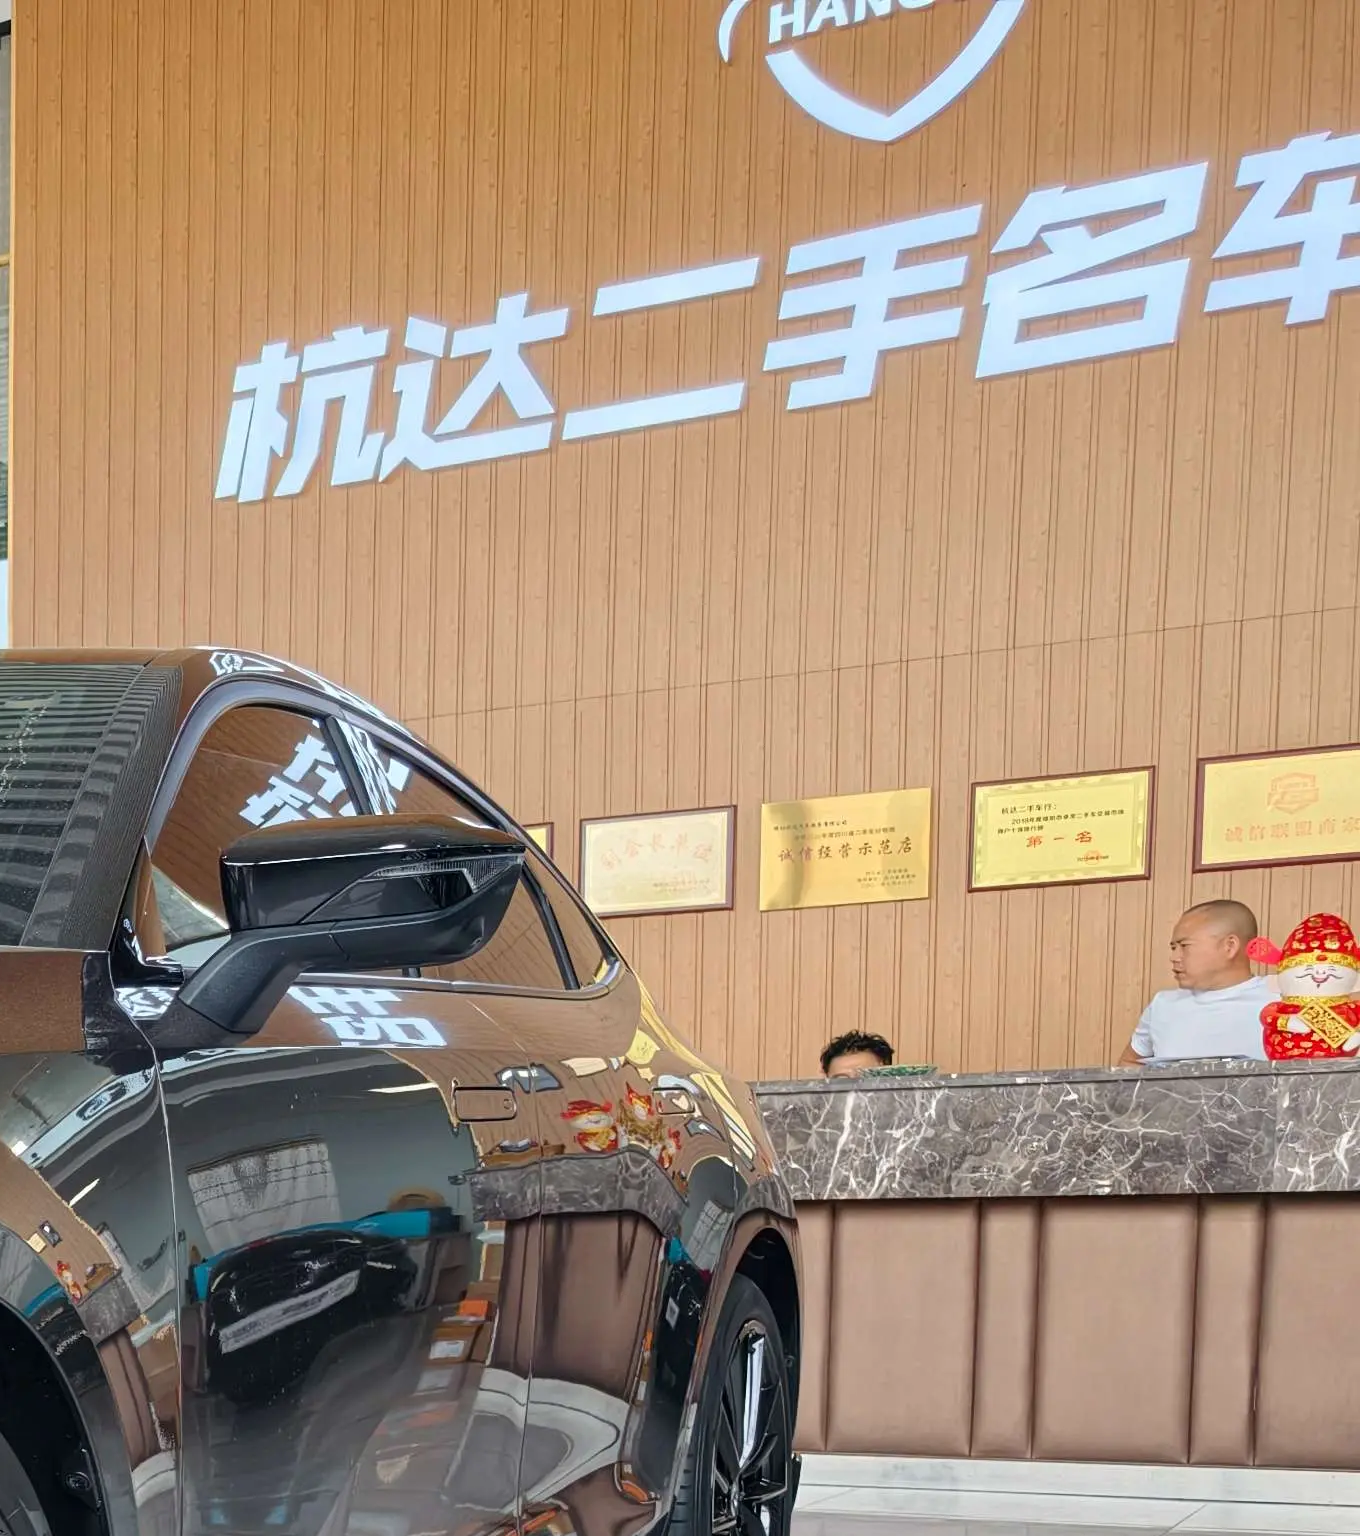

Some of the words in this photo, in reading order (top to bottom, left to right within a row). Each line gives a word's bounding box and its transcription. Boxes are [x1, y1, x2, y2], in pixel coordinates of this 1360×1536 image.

[778, 836, 913, 863] 诚信经营示范店
[1026, 831, 1092, 848] 第一名
